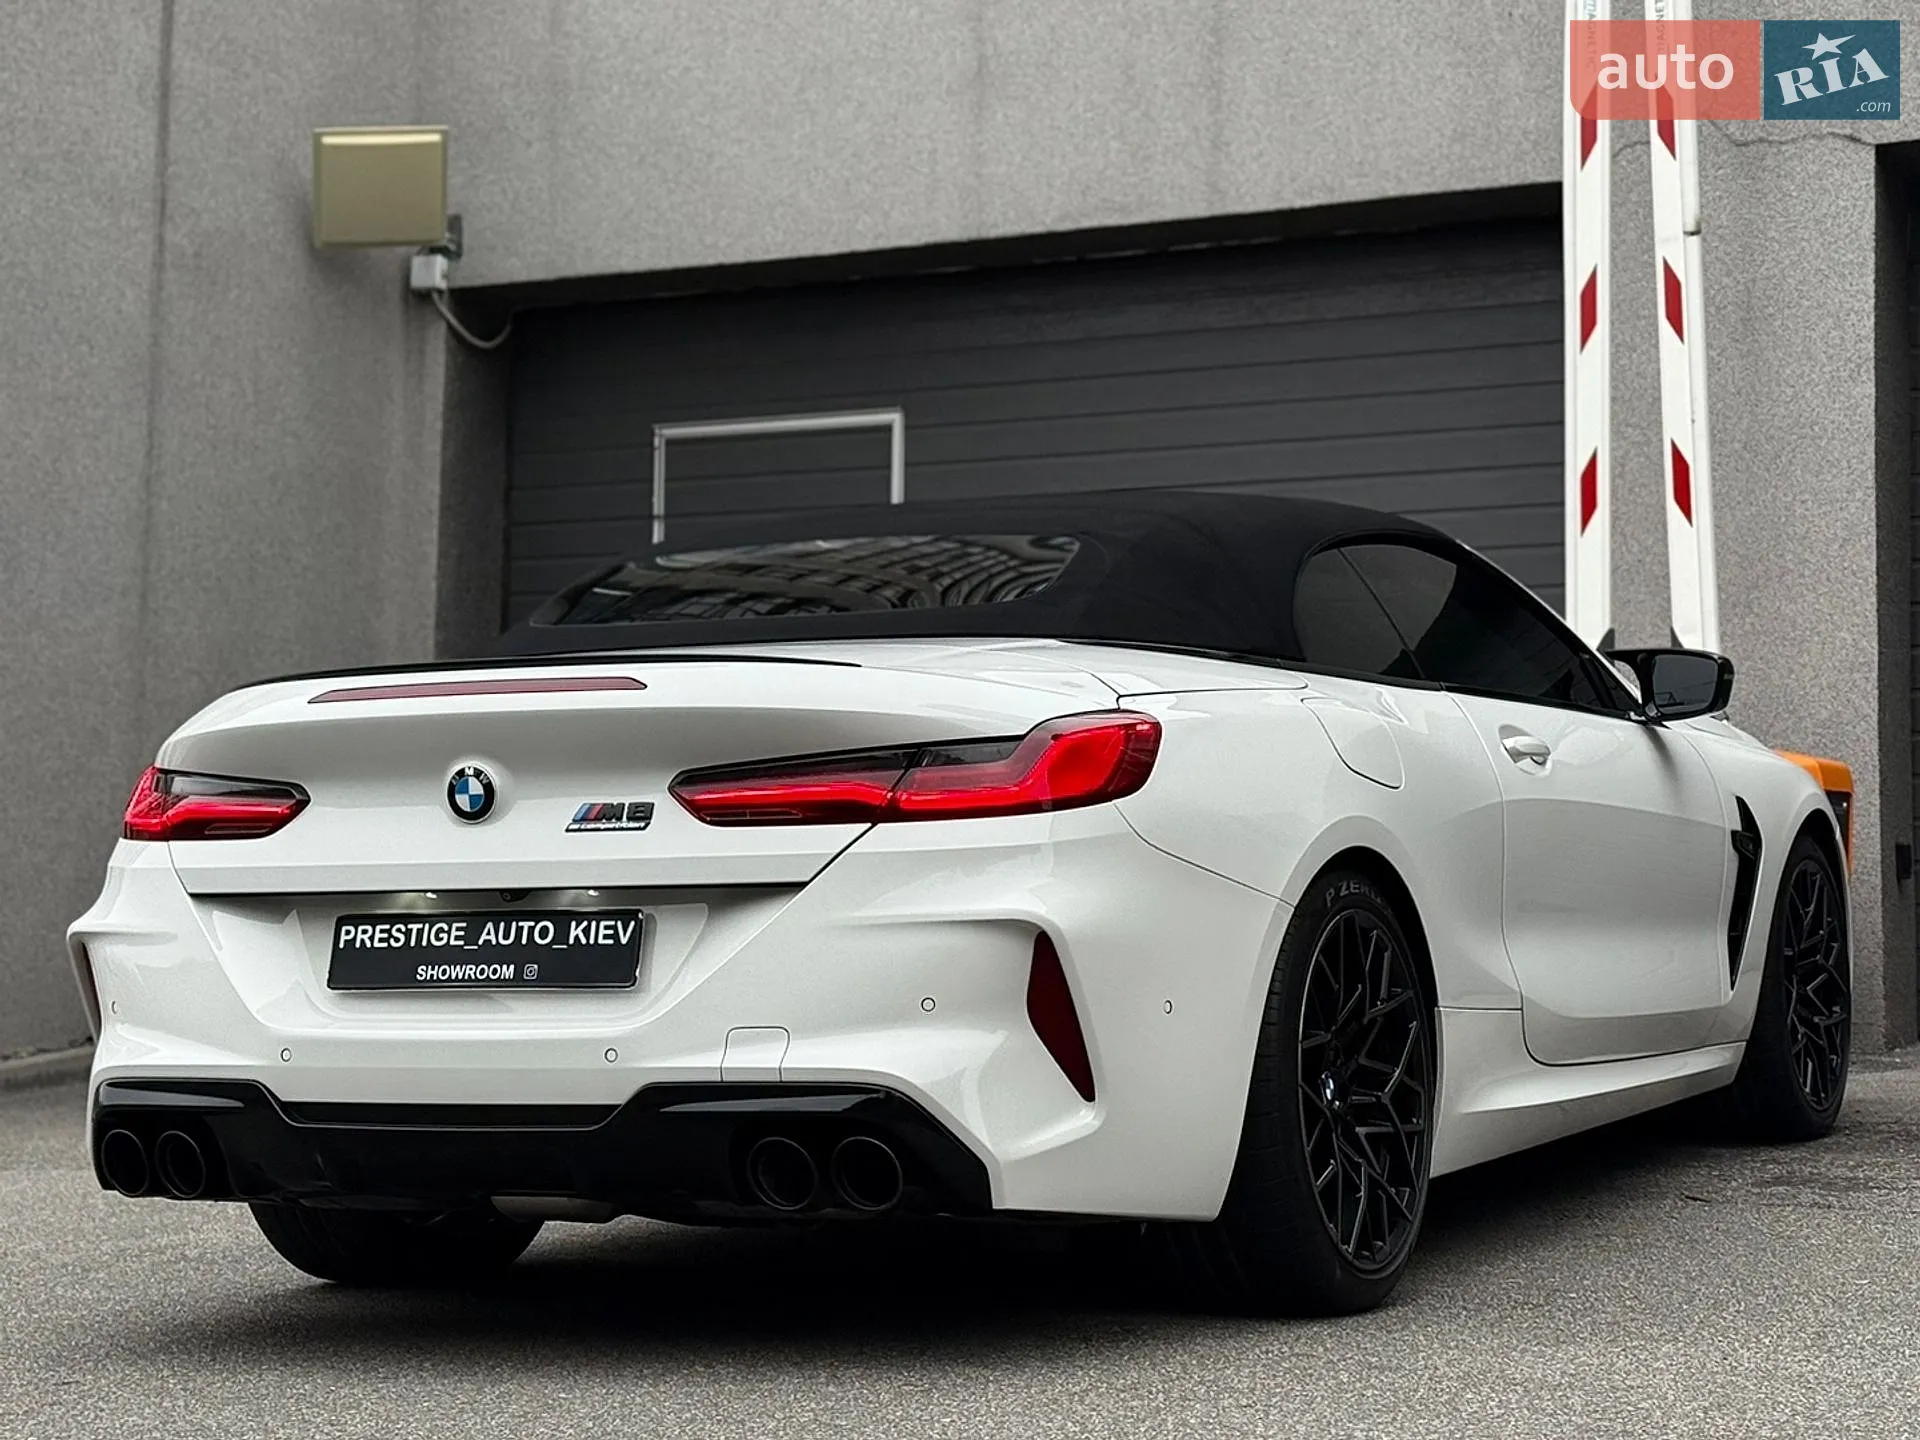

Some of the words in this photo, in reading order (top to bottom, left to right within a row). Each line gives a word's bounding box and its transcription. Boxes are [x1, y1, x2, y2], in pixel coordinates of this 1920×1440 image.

[1326, 887, 1336, 908] P
[338, 920, 636, 950] PRESTIGE_AUTO_KIEV
[416, 964, 515, 981] SHOWROOM
